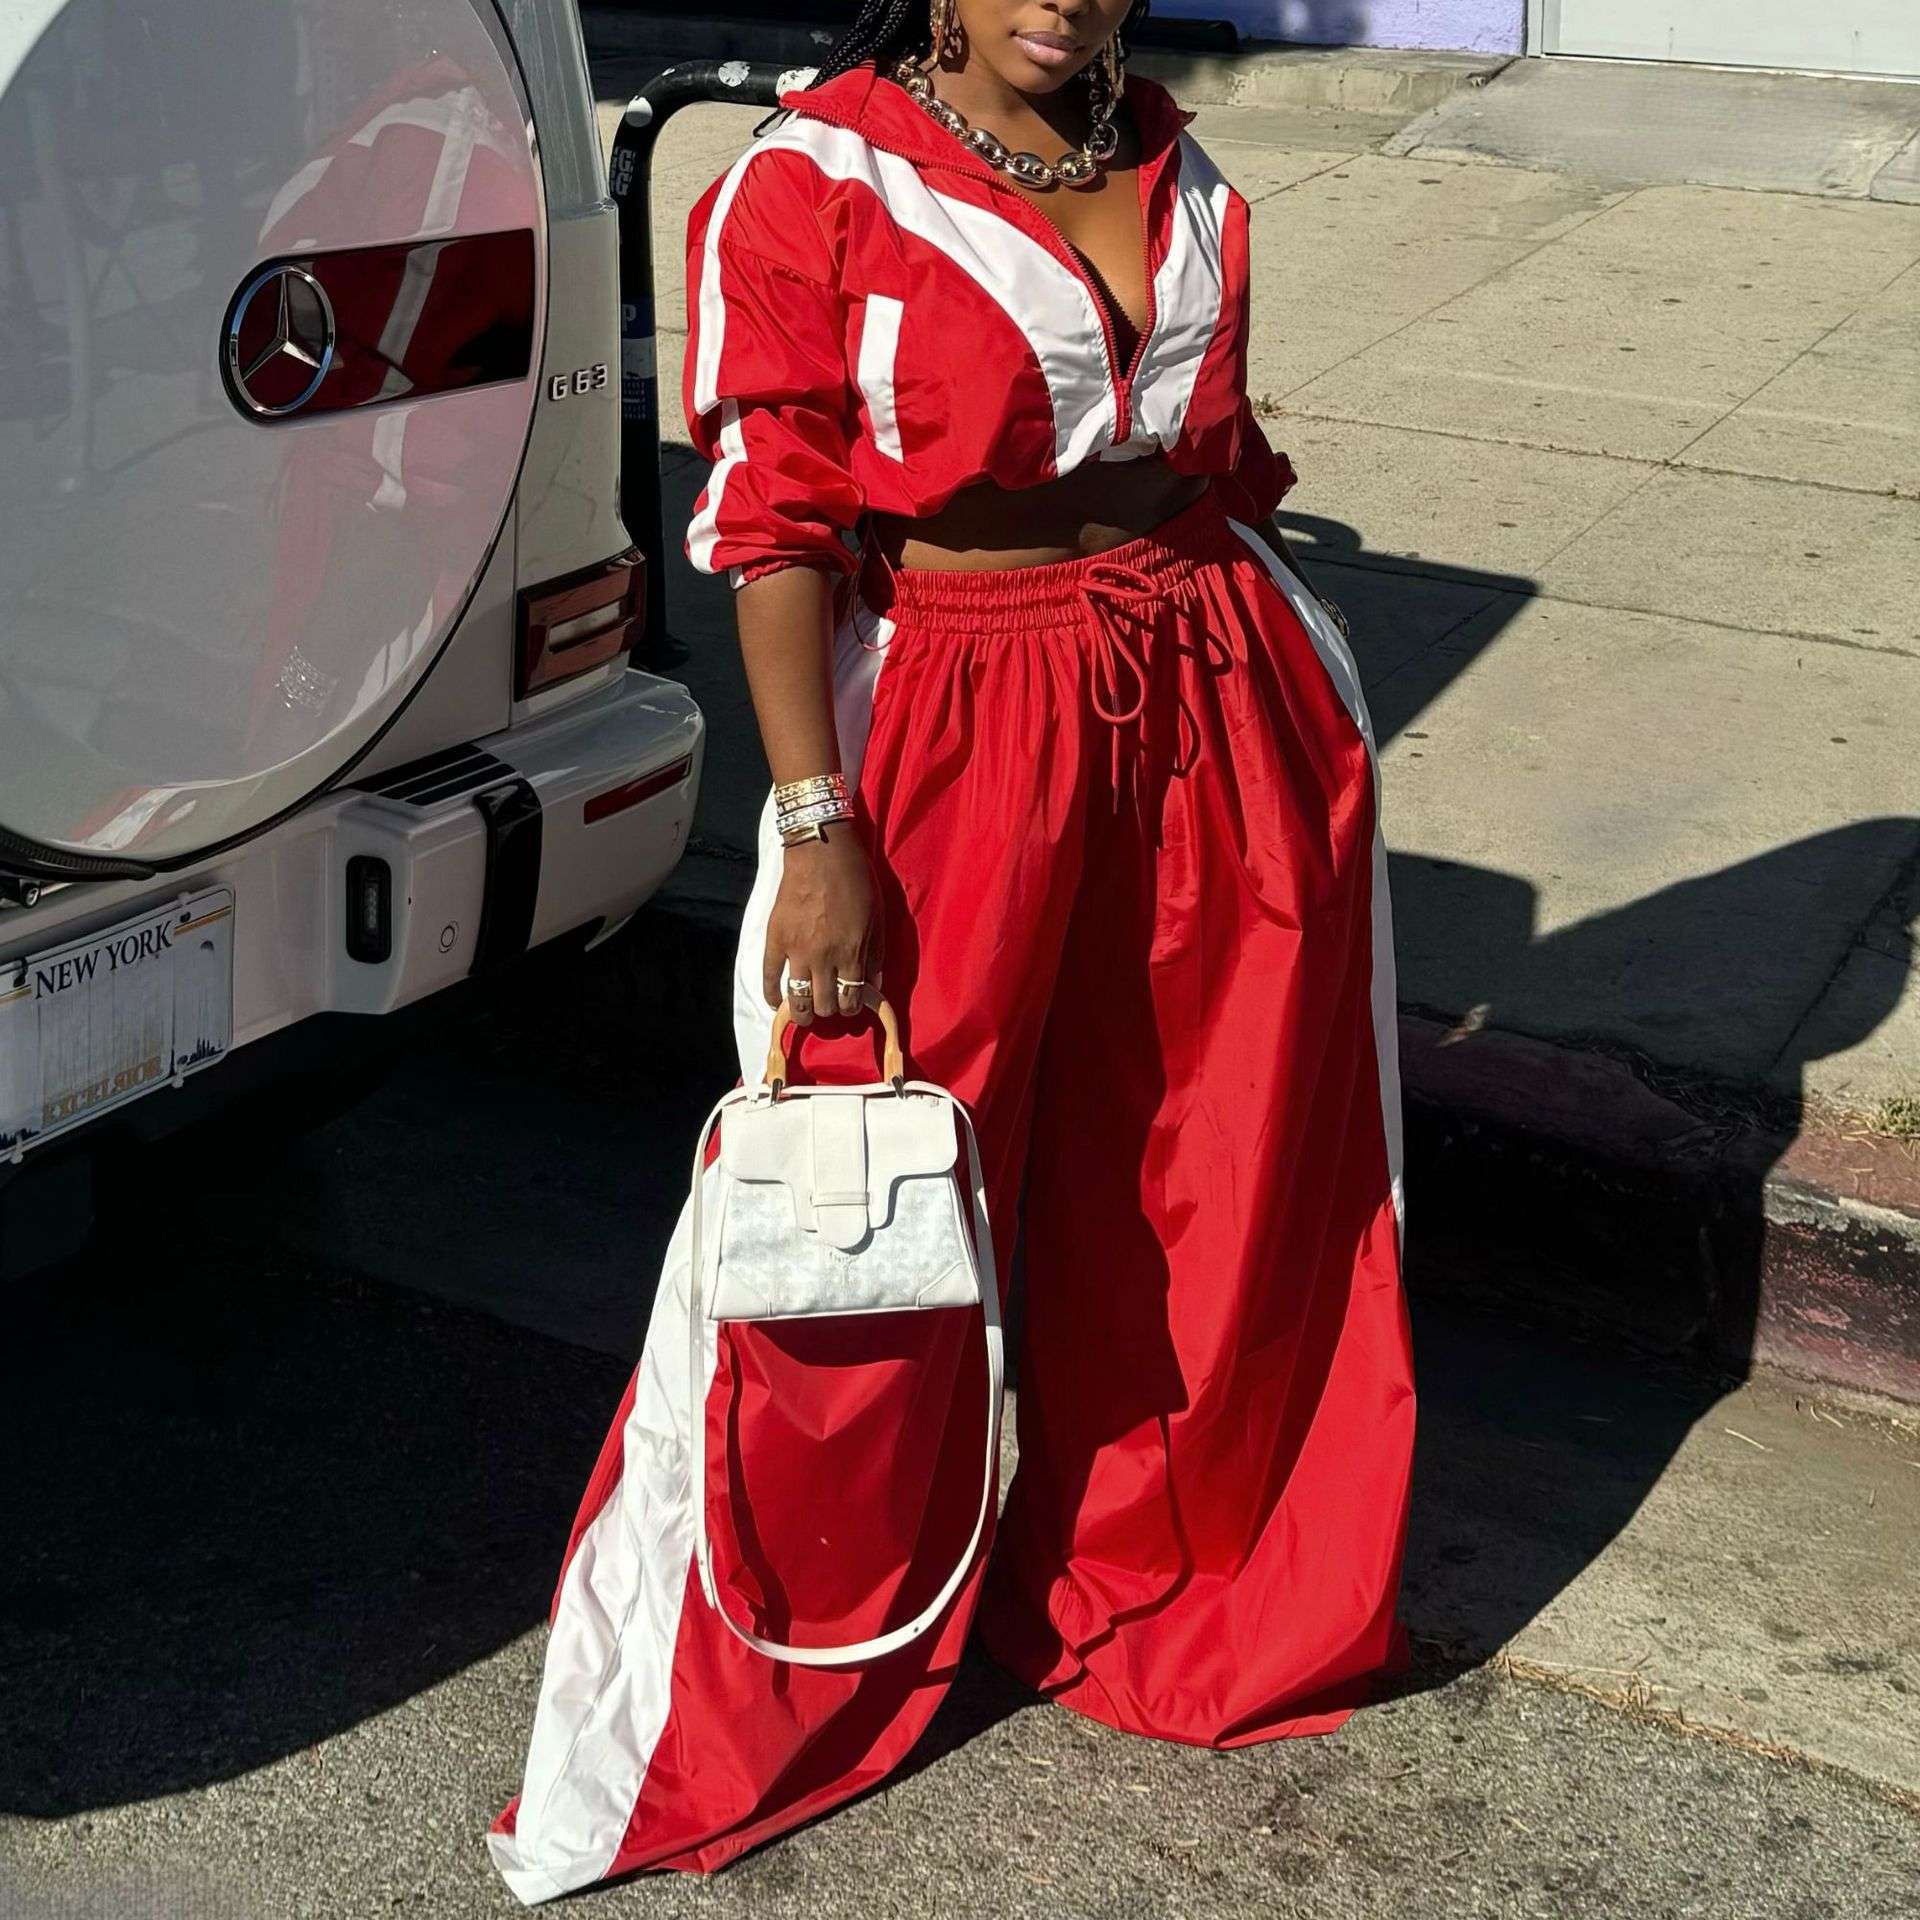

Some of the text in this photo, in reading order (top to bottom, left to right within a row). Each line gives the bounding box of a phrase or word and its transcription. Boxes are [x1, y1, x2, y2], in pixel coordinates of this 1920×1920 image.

[550, 364, 608, 400] G 63
[35, 920, 173, 999] NEW YORK
